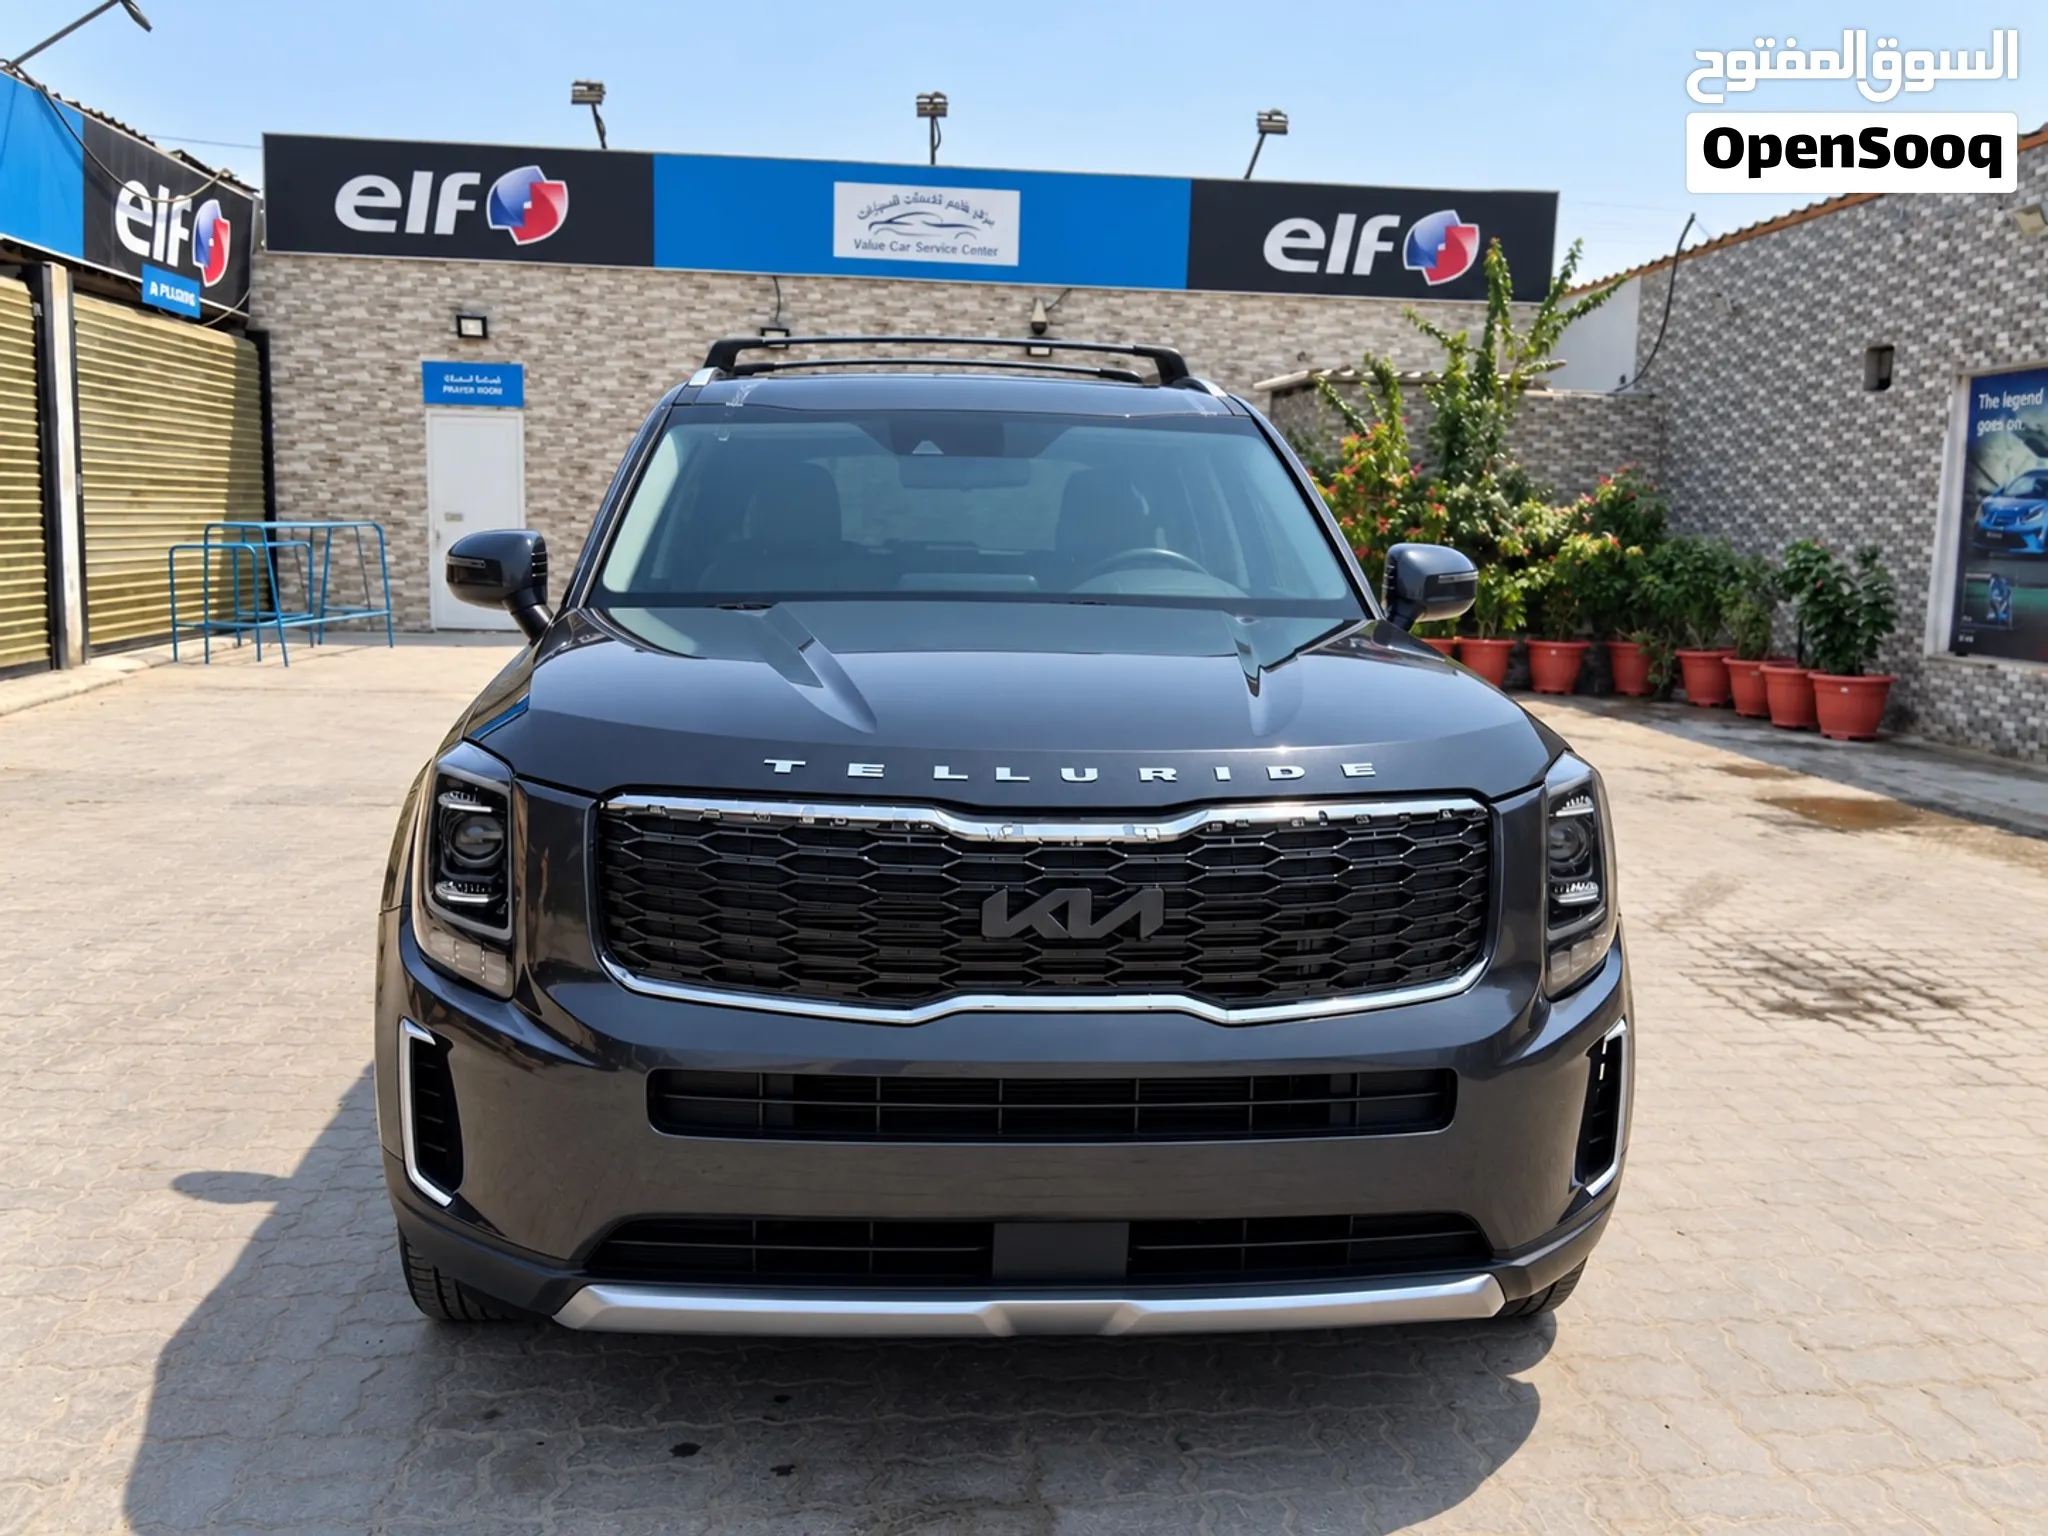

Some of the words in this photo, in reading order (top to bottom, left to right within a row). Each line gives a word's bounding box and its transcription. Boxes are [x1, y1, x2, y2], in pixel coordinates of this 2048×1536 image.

[334, 170, 482, 235] elf
[115, 180, 193, 268] elf
[853, 238, 886, 251] Value
[889, 240, 911, 252] Car
[915, 242, 957, 255] Service
[961, 244, 998, 257] Center
[1263, 213, 1400, 276] elf
[1978, 393, 2000, 409] The
[2002, 387, 2044, 411] legend
[1977, 420, 2003, 436] goes
[764, 758, 1376, 782] TELLURIDE
[981, 888, 1164, 940] KIA
